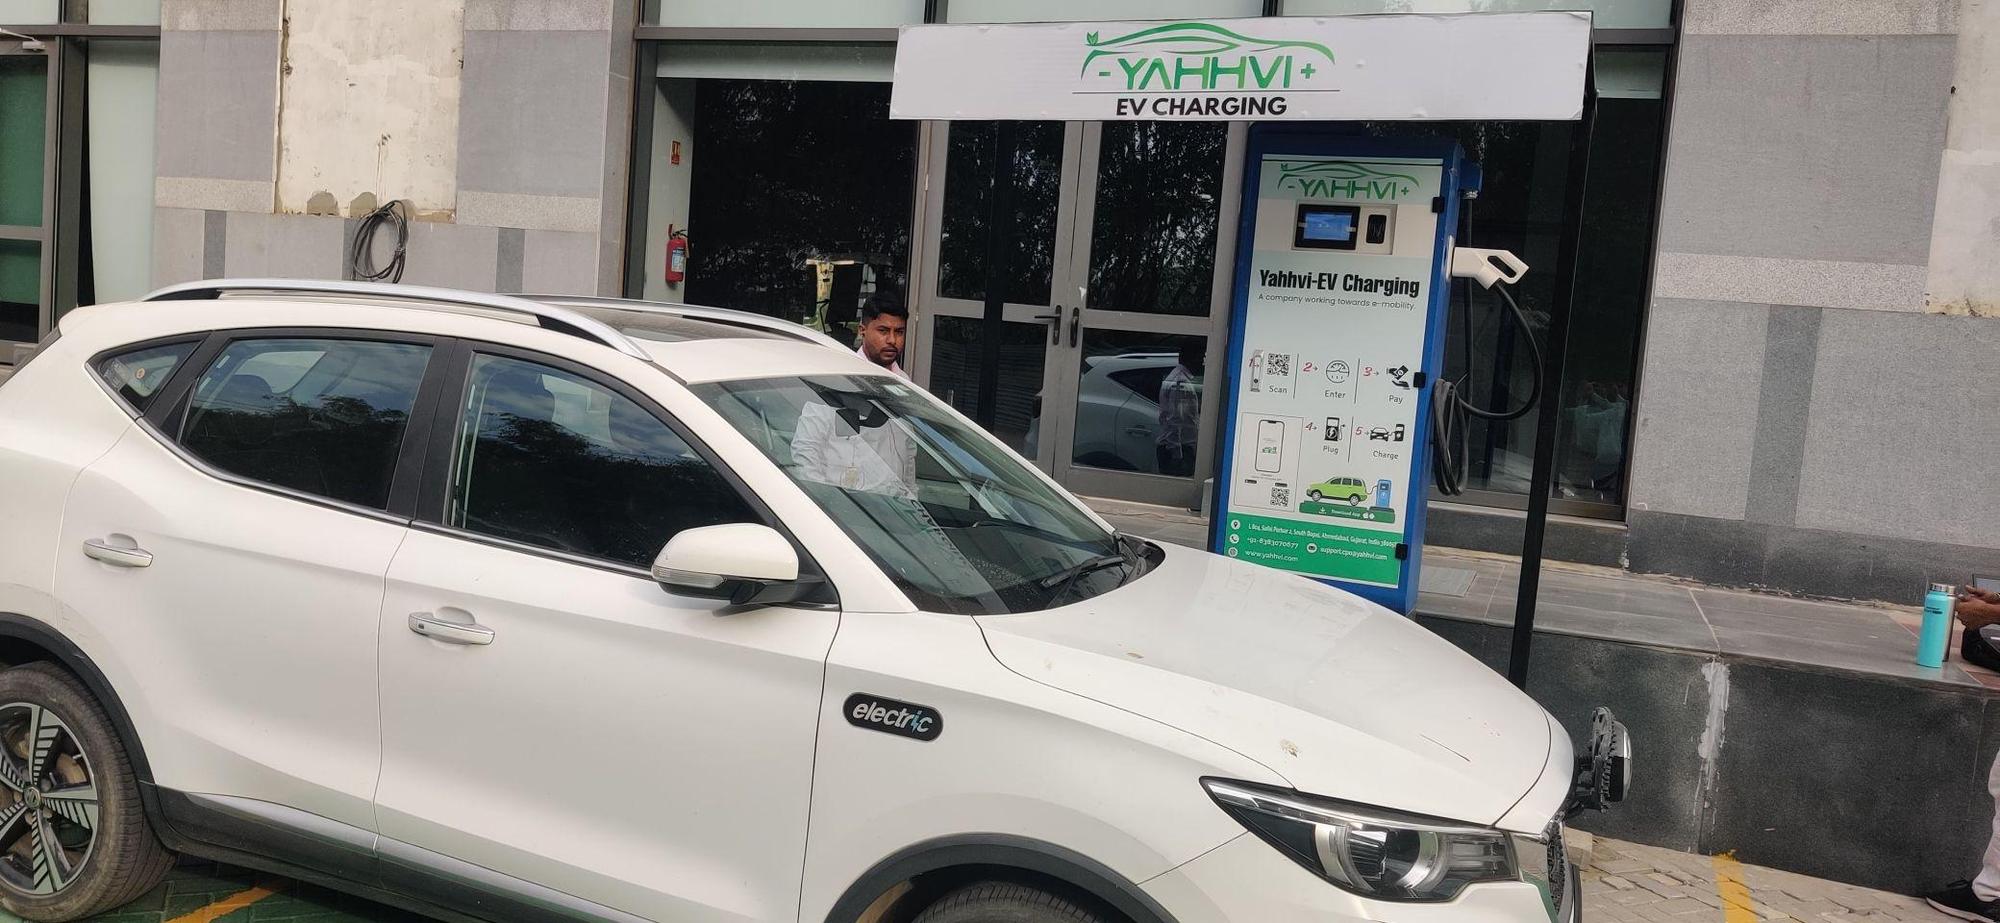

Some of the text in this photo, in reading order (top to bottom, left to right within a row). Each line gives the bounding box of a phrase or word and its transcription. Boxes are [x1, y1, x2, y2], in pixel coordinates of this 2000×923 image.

[1116, 96, 1287, 116] EV CHARGING
[1260, 269, 1420, 298] Yahhvi-EV Charging
[1265, 295, 1302, 303] company
[1305, 296, 1335, 306] working
[1338, 298, 1370, 307] towards
[1268, 385, 1287, 394] Scan
[1324, 389, 1346, 399] Enter
[1388, 395, 1403, 404] Pay
[1323, 445, 1339, 454] Plug
[1373, 450, 1399, 460] Charge
[852, 701, 933, 733] electric
